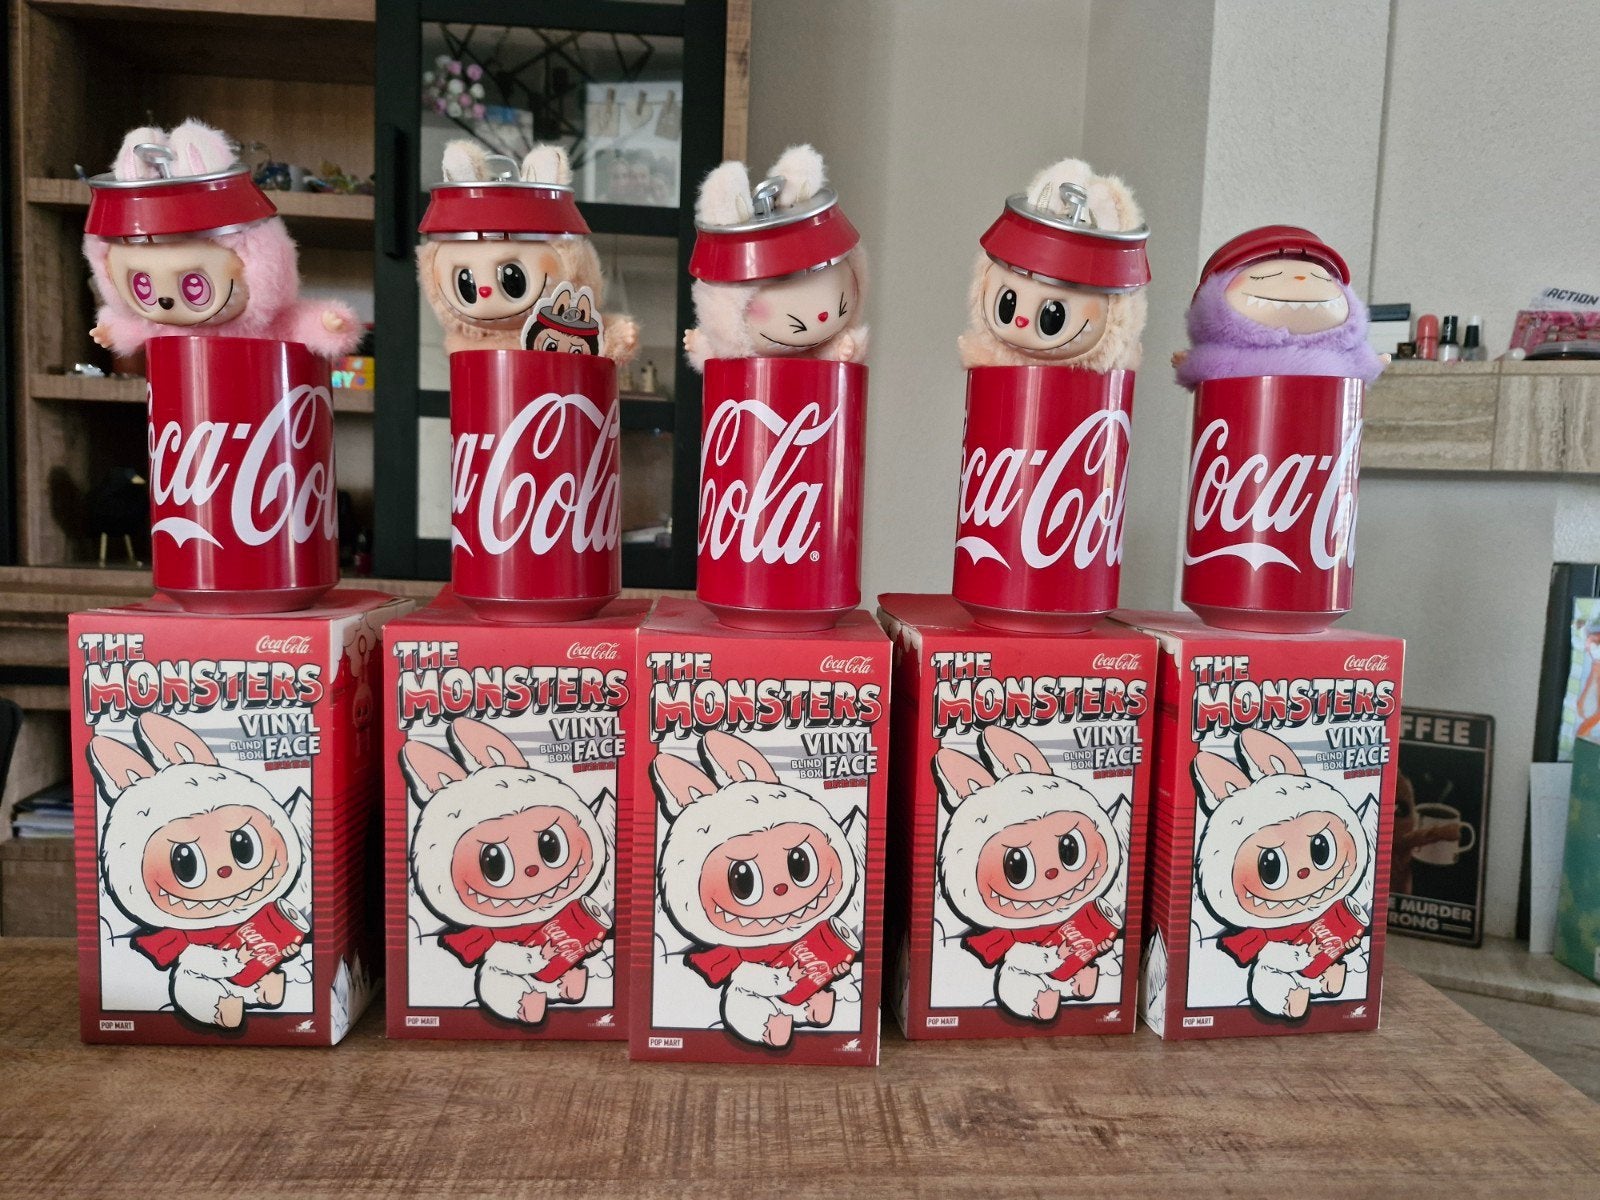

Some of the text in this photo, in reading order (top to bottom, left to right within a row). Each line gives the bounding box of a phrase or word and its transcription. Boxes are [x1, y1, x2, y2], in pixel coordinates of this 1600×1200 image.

[1547, 288, 1599, 305] ACTION
[147, 383, 338, 549] oca-Col
[451, 393, 620, 557] a-Cola
[955, 409, 1131, 570] ca-Col
[1184, 418, 1363, 573] Coca-C
[78, 633, 145, 664] THE
[256, 635, 312, 654] Coca-Cola
[393, 641, 459, 670] THE
[567, 642, 618, 660] Coca-Cola
[646, 652, 712, 682] THE
[819, 655, 872, 674] Coca-Cola
[930, 652, 992, 681] THE
[1092, 653, 1140, 671] Coca-Cola
[1191, 656, 1249, 683] THE
[1343, 655, 1389, 672] Coca-Cola
[83, 660, 324, 723] MONSTERS
[398, 666, 630, 730] MONSTERS
[649, 679, 882, 743] MONSTERS
[933, 676, 1148, 738] MONSTERS
[1192, 678, 1396, 741] MONSTERS
[239, 713, 320, 737] VINYL
[549, 717, 626, 740] VINYL
[1400, 715, 1470, 745] FFEE
[230, 741, 261, 751] BLIND
[263, 736, 320, 760] FACE
[801, 732, 877, 756] VINYL
[1074, 725, 1143, 749] VINYL
[1326, 726, 1390, 749] VINYL
[239, 751, 263, 760] BOX
[540, 744, 570, 754] BLIND
[549, 754, 570, 763] BOX
[572, 738, 626, 761] FACE
[1063, 752, 1092, 761] BLIND
[1093, 747, 1142, 769] FACE
[1315, 752, 1343, 762] BLIND
[1344, 746, 1390, 770] FACE
[791, 759, 822, 769] BLIND
[800, 769, 822, 778] BOX
[823, 755, 877, 779] FACE
[1070, 761, 1092, 770] BOX
[1323, 761, 1343, 771] BOX
[1388, 911, 1440, 930] RONG
[1401, 899, 1472, 921] MURDER
[101, 1021, 132, 1030] POP MART
[407, 1017, 438, 1025] POP MART
[928, 1017, 957, 1026] POP MART
[1184, 1017, 1212, 1026] POP MART
[650, 1038, 681, 1047] POP MART
